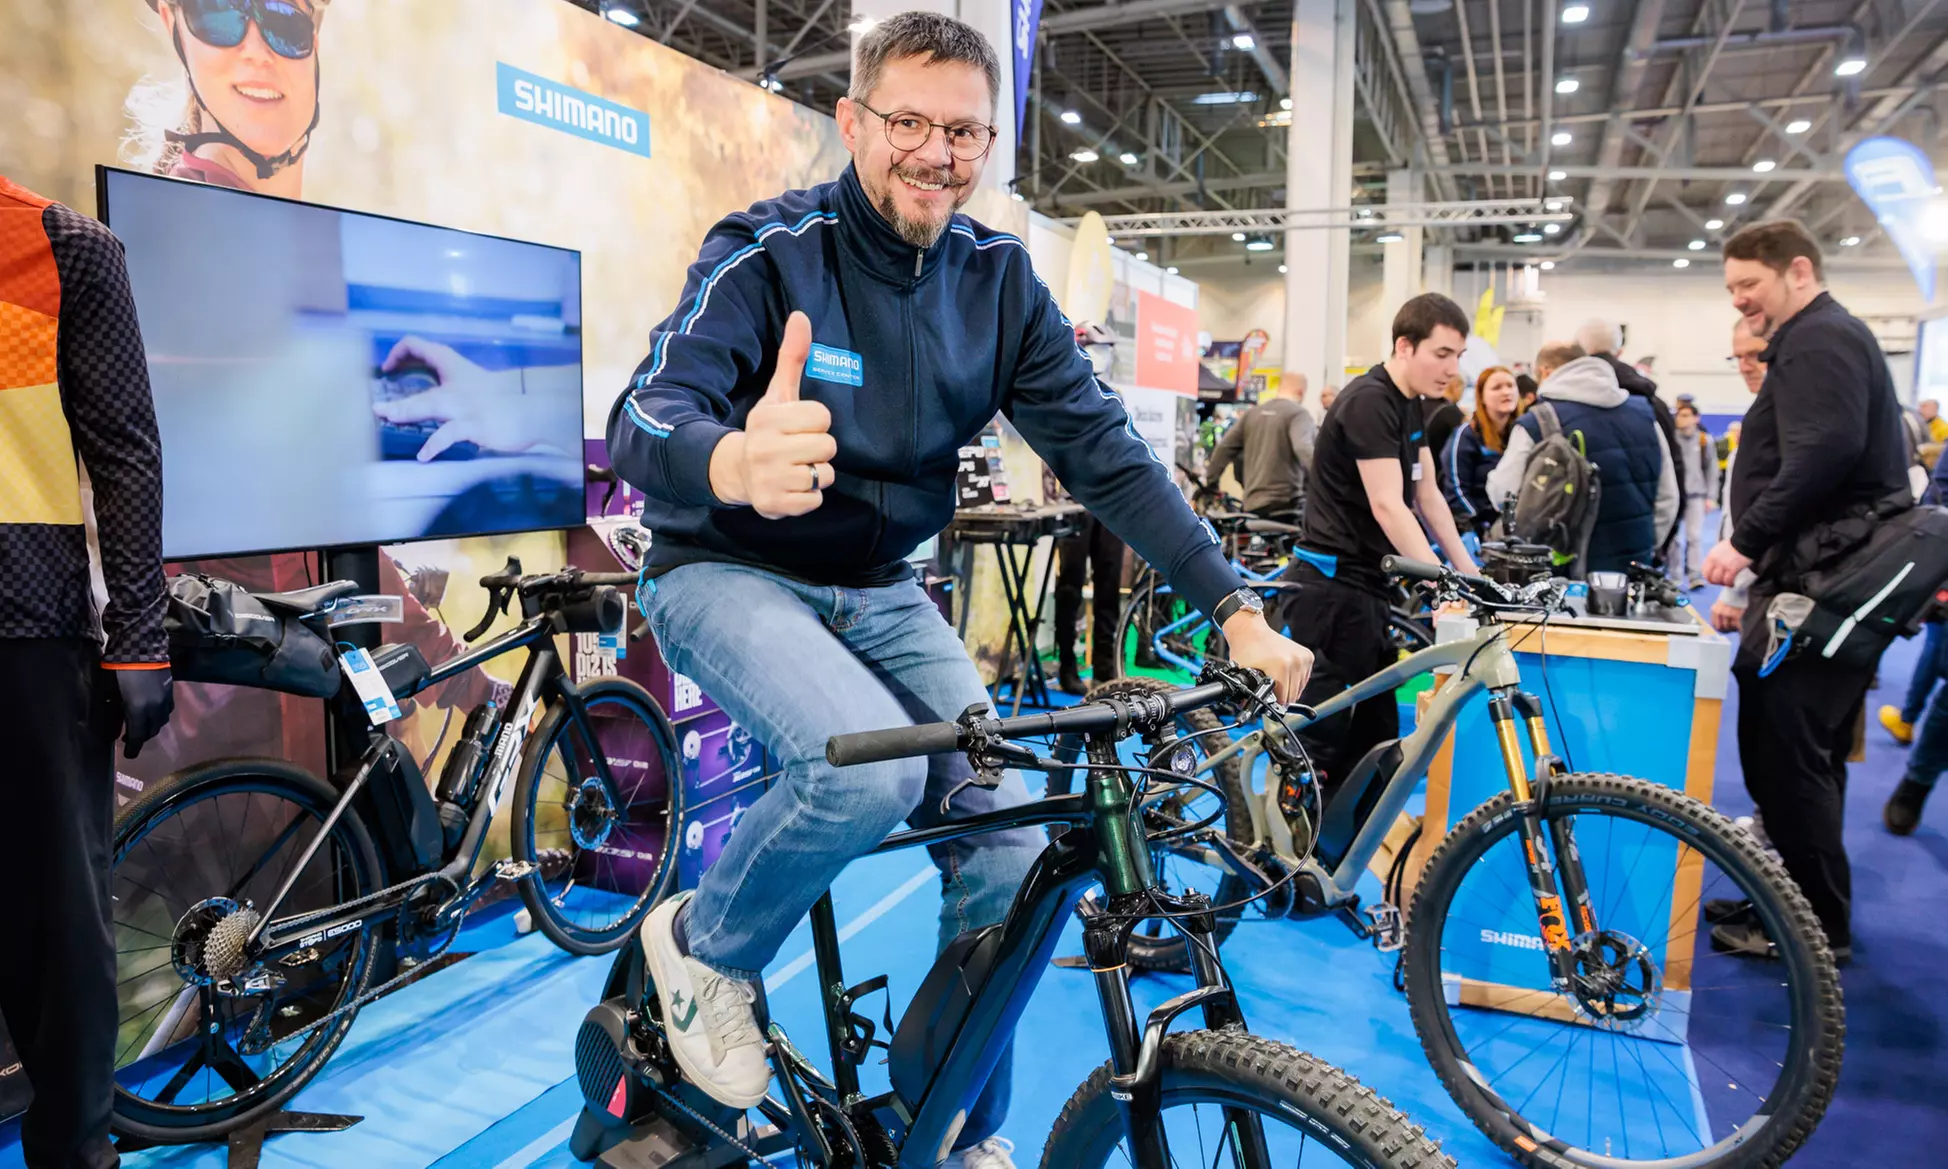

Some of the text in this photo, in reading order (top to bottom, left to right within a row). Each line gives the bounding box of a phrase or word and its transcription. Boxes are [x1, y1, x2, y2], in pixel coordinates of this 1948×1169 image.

[514, 79, 638, 145] SHIMANO
[813, 350, 860, 371] SHIMANO
[494, 722, 514, 759] MANO
[1480, 929, 1546, 952] SHIMA
[1539, 894, 1573, 952] FOX
